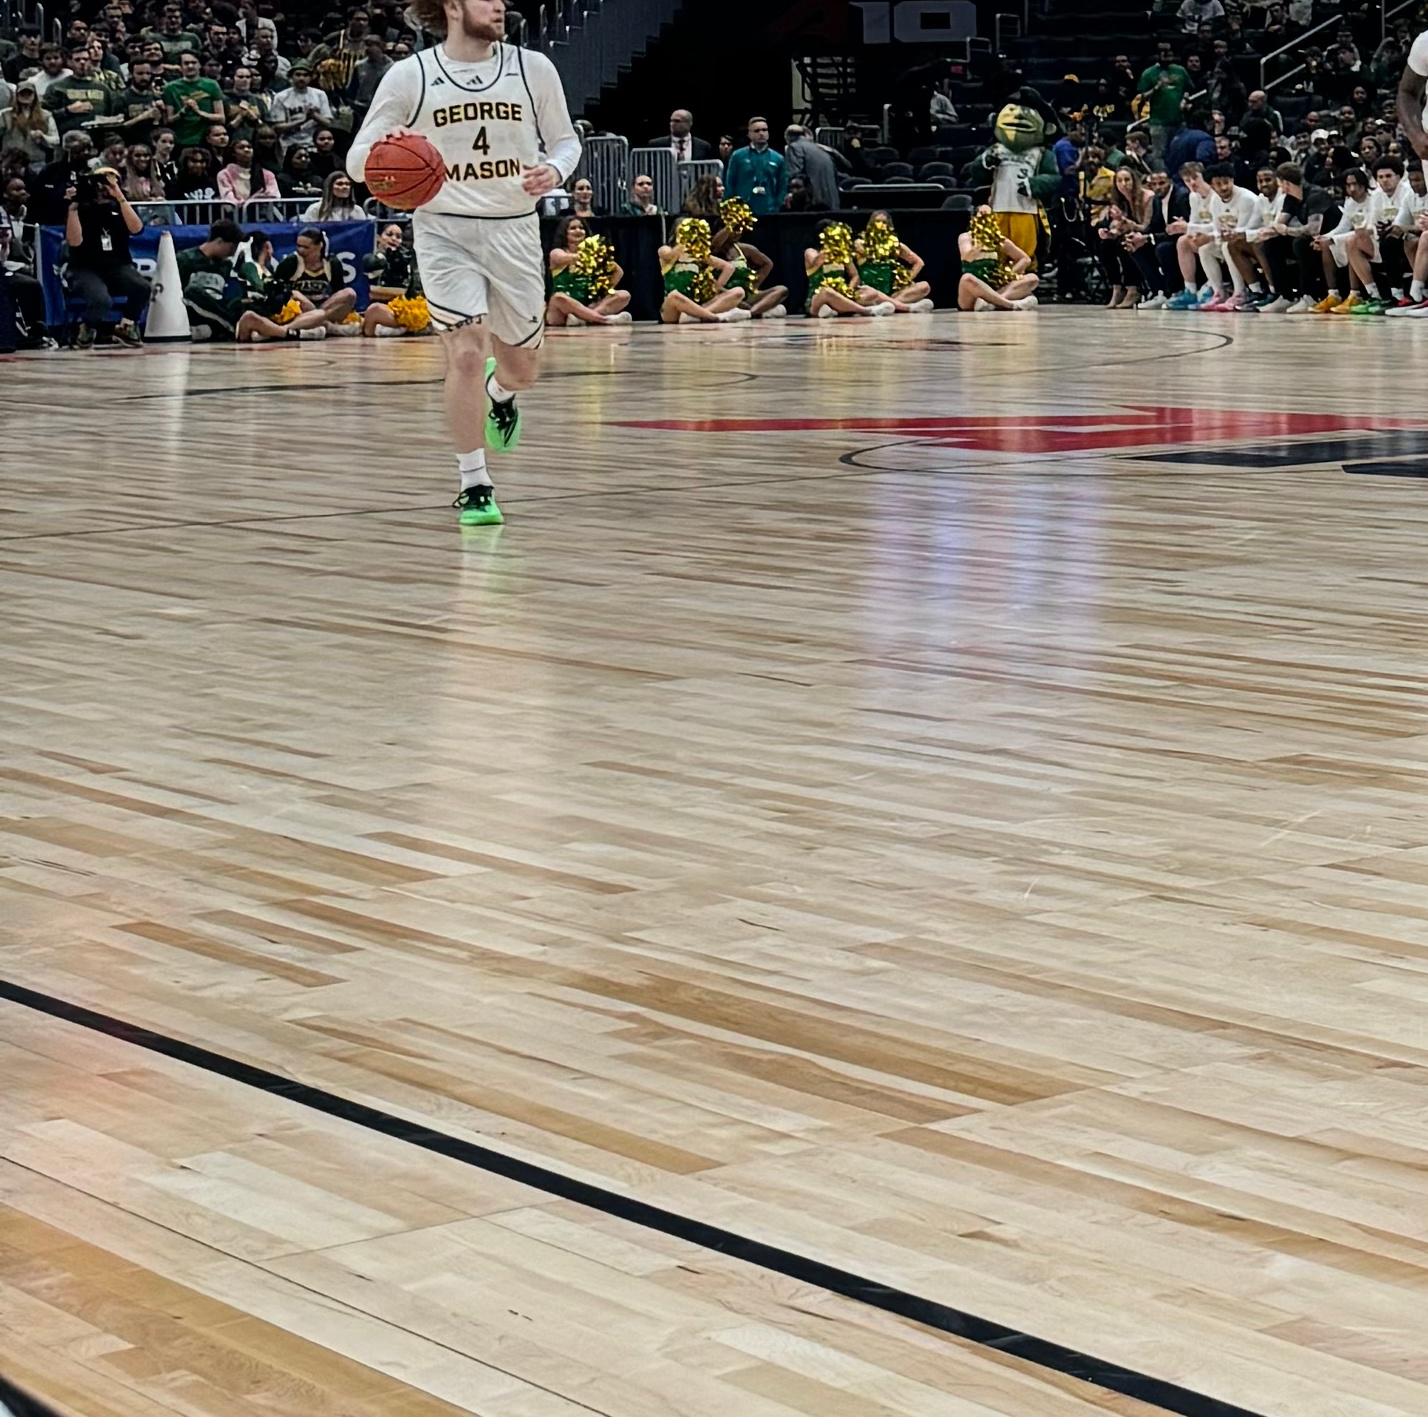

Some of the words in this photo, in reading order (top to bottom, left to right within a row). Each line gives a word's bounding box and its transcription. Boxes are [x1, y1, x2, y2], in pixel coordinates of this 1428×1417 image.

[433, 102, 522, 127] GEORGE
[472, 126, 490, 155] 4
[444, 158, 520, 182] MASON
